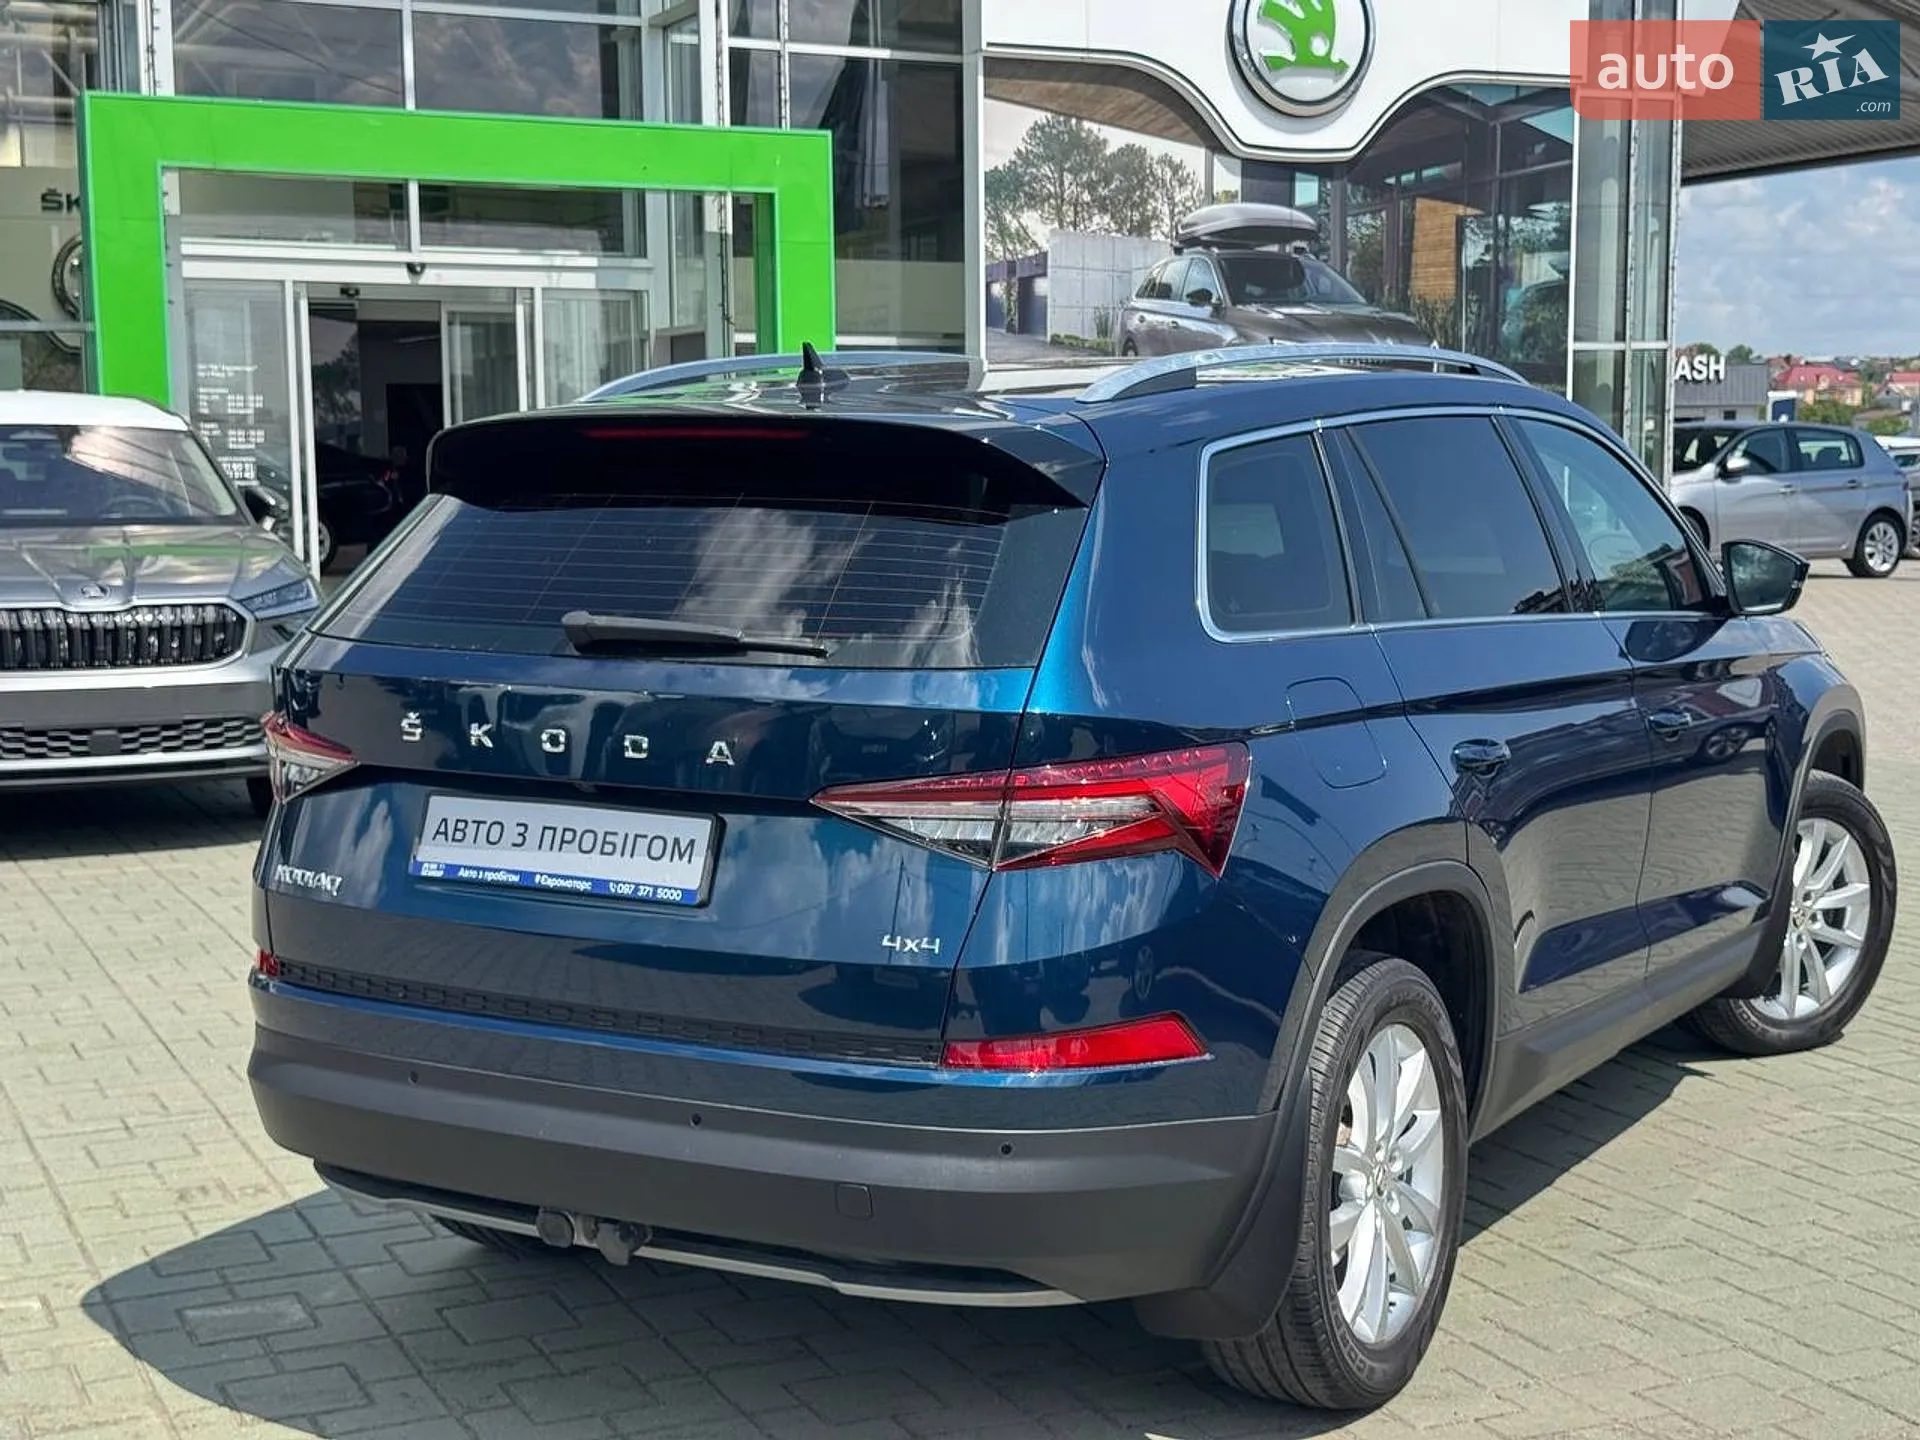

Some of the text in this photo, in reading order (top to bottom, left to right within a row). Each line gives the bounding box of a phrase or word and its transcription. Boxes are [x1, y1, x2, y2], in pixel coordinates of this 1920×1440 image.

[400, 711, 735, 767] ŠKODA
[432, 817, 505, 847] АВТО
[538, 825, 697, 865] ПРОБІГОМ
[616, 883, 635, 896] 097
[637, 885, 653, 898] 371
[656, 887, 683, 901] 5000
[881, 934, 940, 954] 4x4
